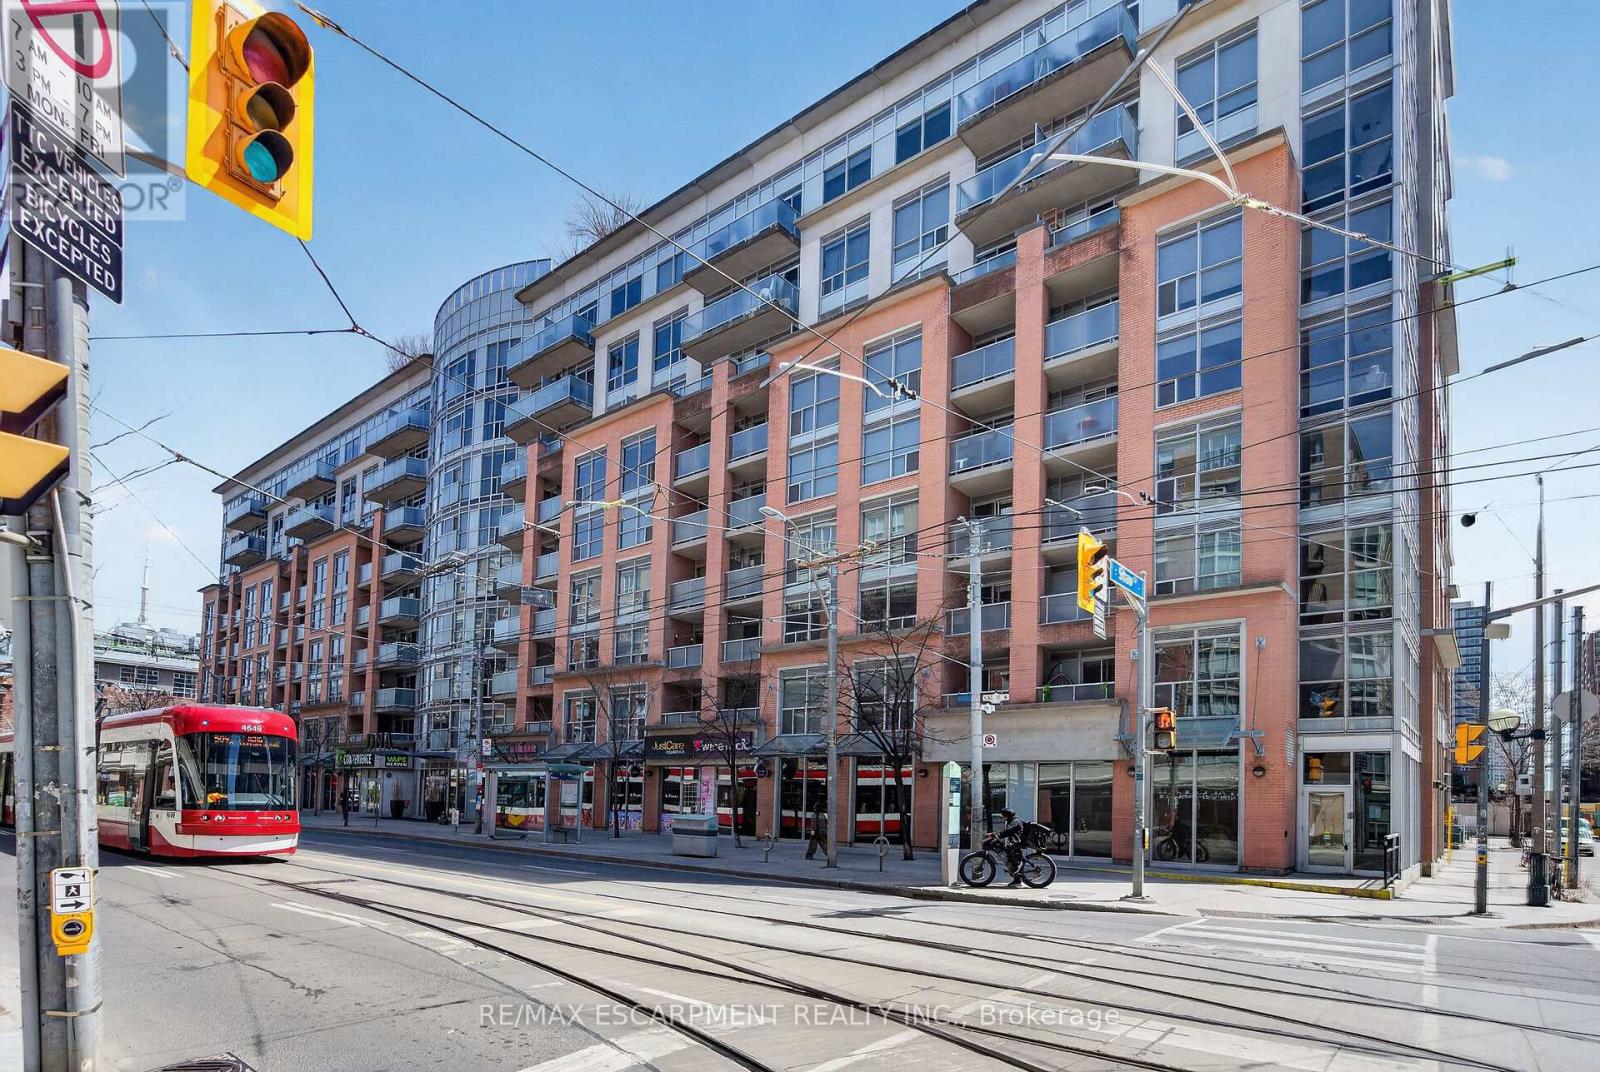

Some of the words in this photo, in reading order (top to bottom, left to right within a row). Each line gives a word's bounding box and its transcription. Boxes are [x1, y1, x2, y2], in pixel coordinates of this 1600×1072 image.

[11, 18, 22, 41] 7
[29, 39, 48, 65] AM
[76, 75, 92, 102] 10
[96, 99, 111, 121] AM
[15, 50, 26, 72] 3
[32, 68, 52, 95] PM
[80, 103, 89, 122] 7
[96, 120, 111, 144] PM
[14, 110, 47, 153] TTC
[53, 143, 120, 215] VEHICLES
[80, 128, 105, 158] FRI
[21, 144, 116, 234] EXCEPTED
[25, 183, 111, 265] BICYCLES
[20, 206, 115, 291] EXCEPTED
